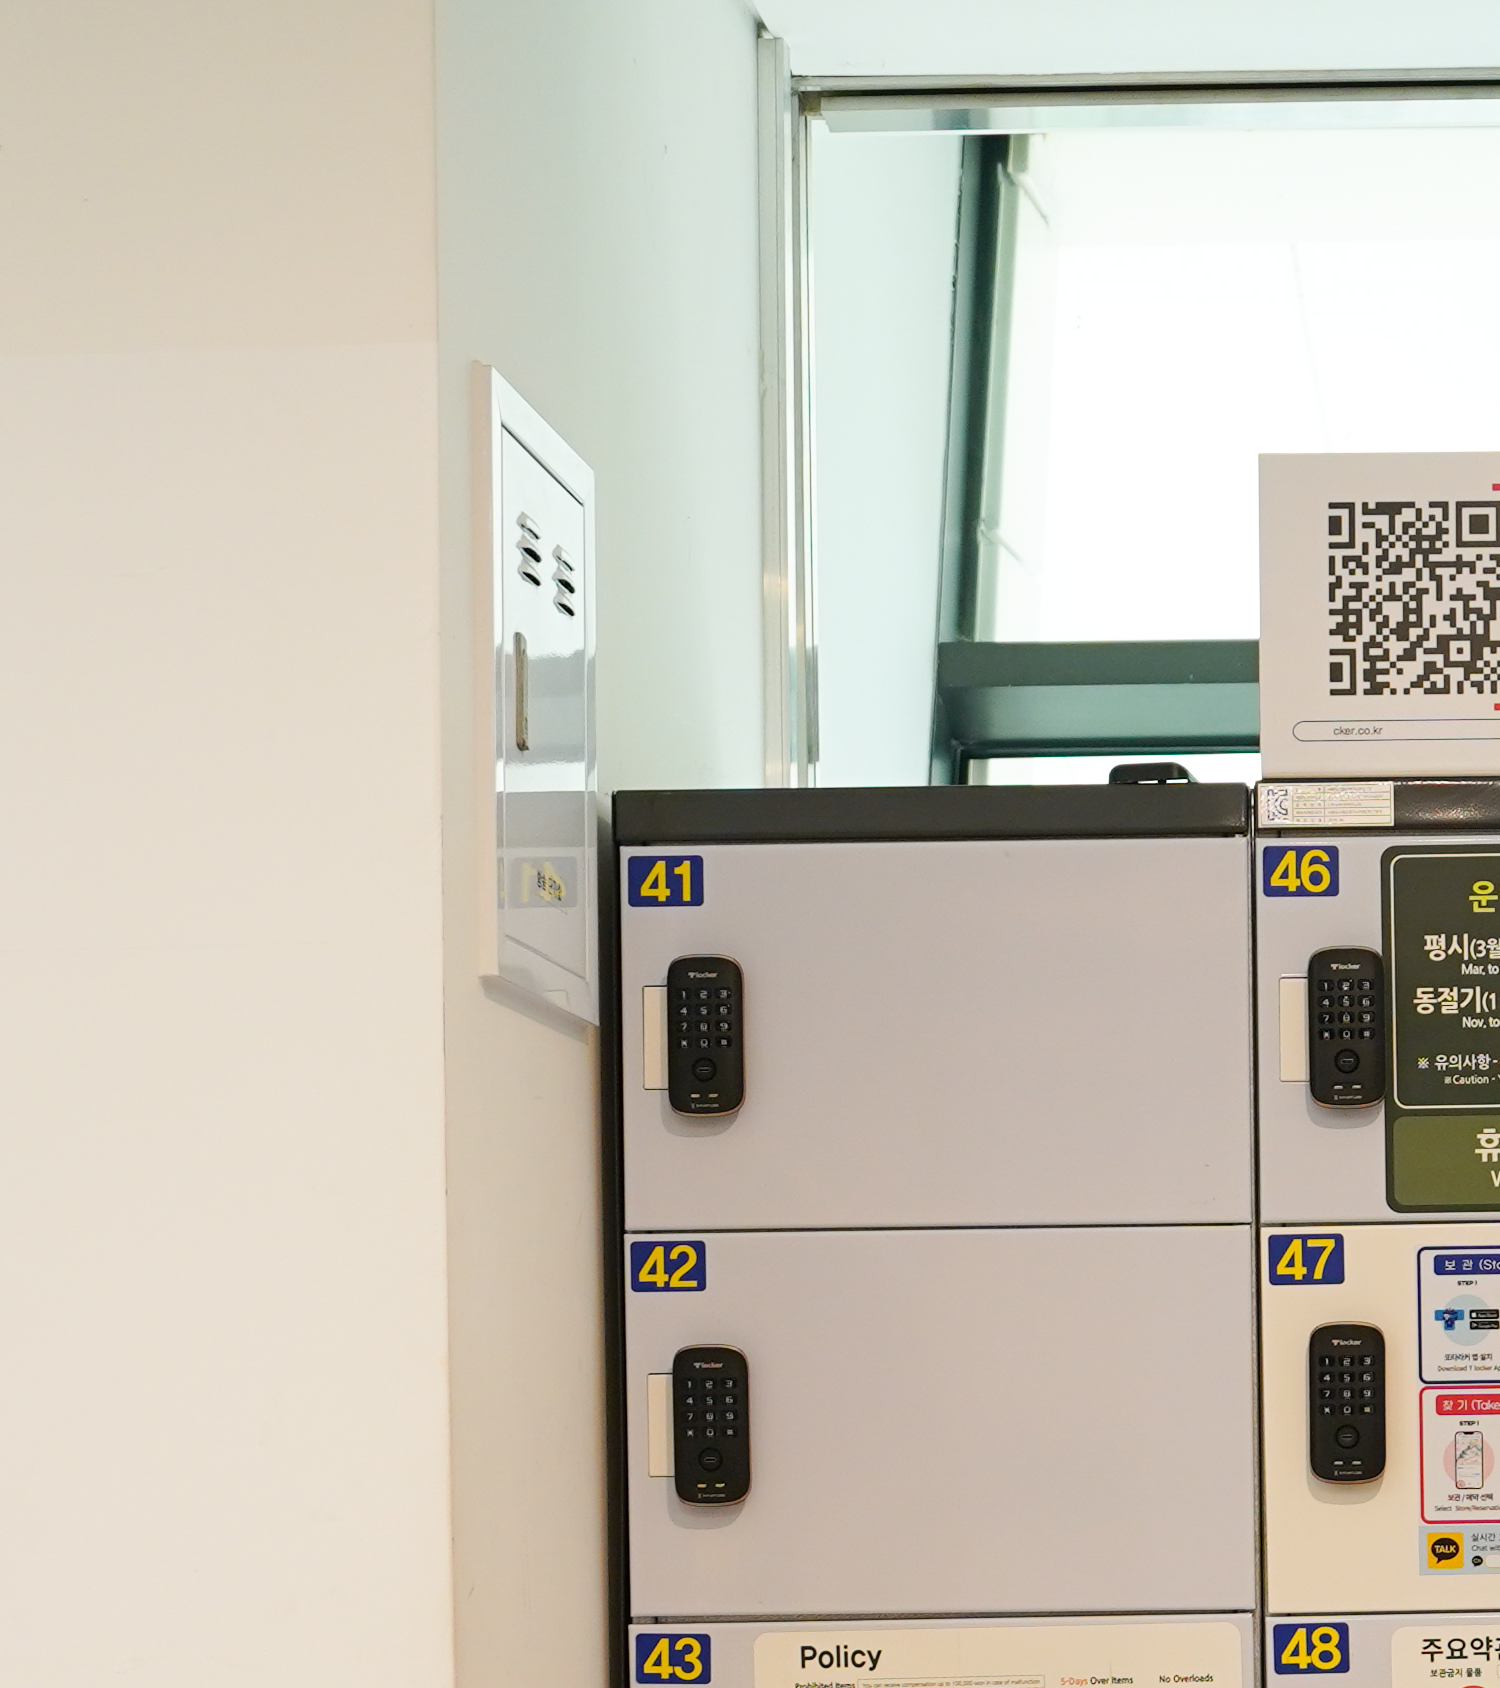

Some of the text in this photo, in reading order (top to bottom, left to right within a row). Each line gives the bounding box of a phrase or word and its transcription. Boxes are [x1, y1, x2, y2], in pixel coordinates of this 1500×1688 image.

[639, 860, 694, 902] 41
[1270, 849, 1331, 892] 46
[638, 1245, 698, 1288] 42
[1276, 1237, 1336, 1281] 47
[1445, 1259, 1456, 1271] 보
[1462, 1259, 1473, 1271] 관
[1458, 1400, 1468, 1411] 기
[1471, 1399, 1500, 1411] (Take
[1434, 1545, 1457, 1554] TALK
[642, 1637, 703, 1681] 43
[800, 1645, 882, 1671] Policy
[1281, 1626, 1341, 1670] 48
[1061, 1676, 1133, 1687] 5-Days Over Items
